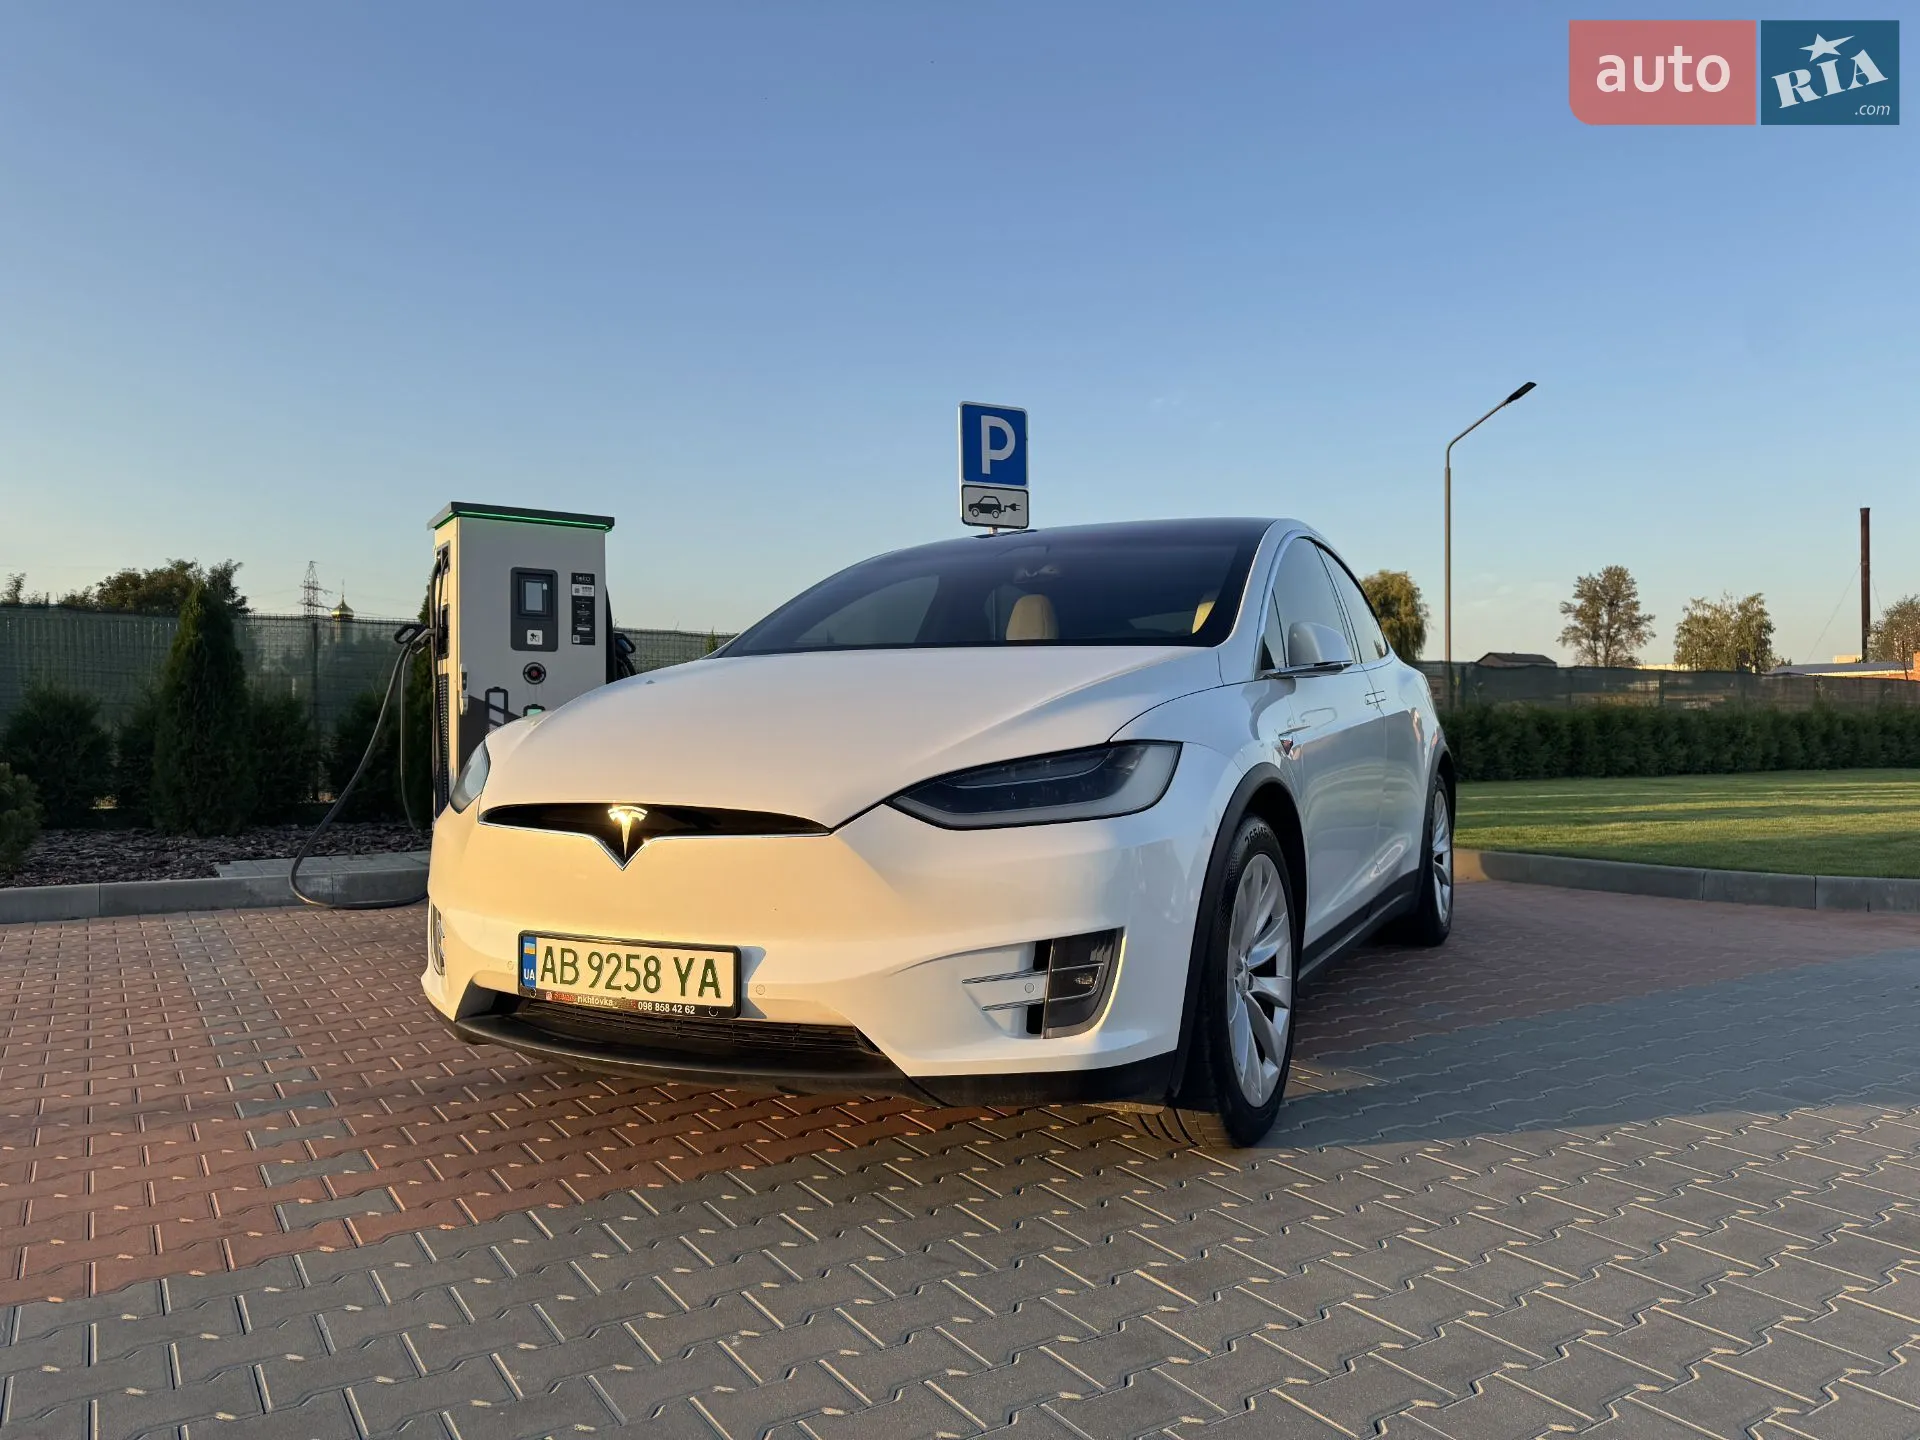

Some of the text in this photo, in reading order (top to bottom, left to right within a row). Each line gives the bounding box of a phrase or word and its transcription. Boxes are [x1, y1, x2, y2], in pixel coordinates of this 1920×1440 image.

[981, 415, 1016, 475] P
[523, 968, 536, 981] UA
[540, 946, 722, 999] AB 9258 YA
[637, 1001, 696, 1015] 098 858 42 62
